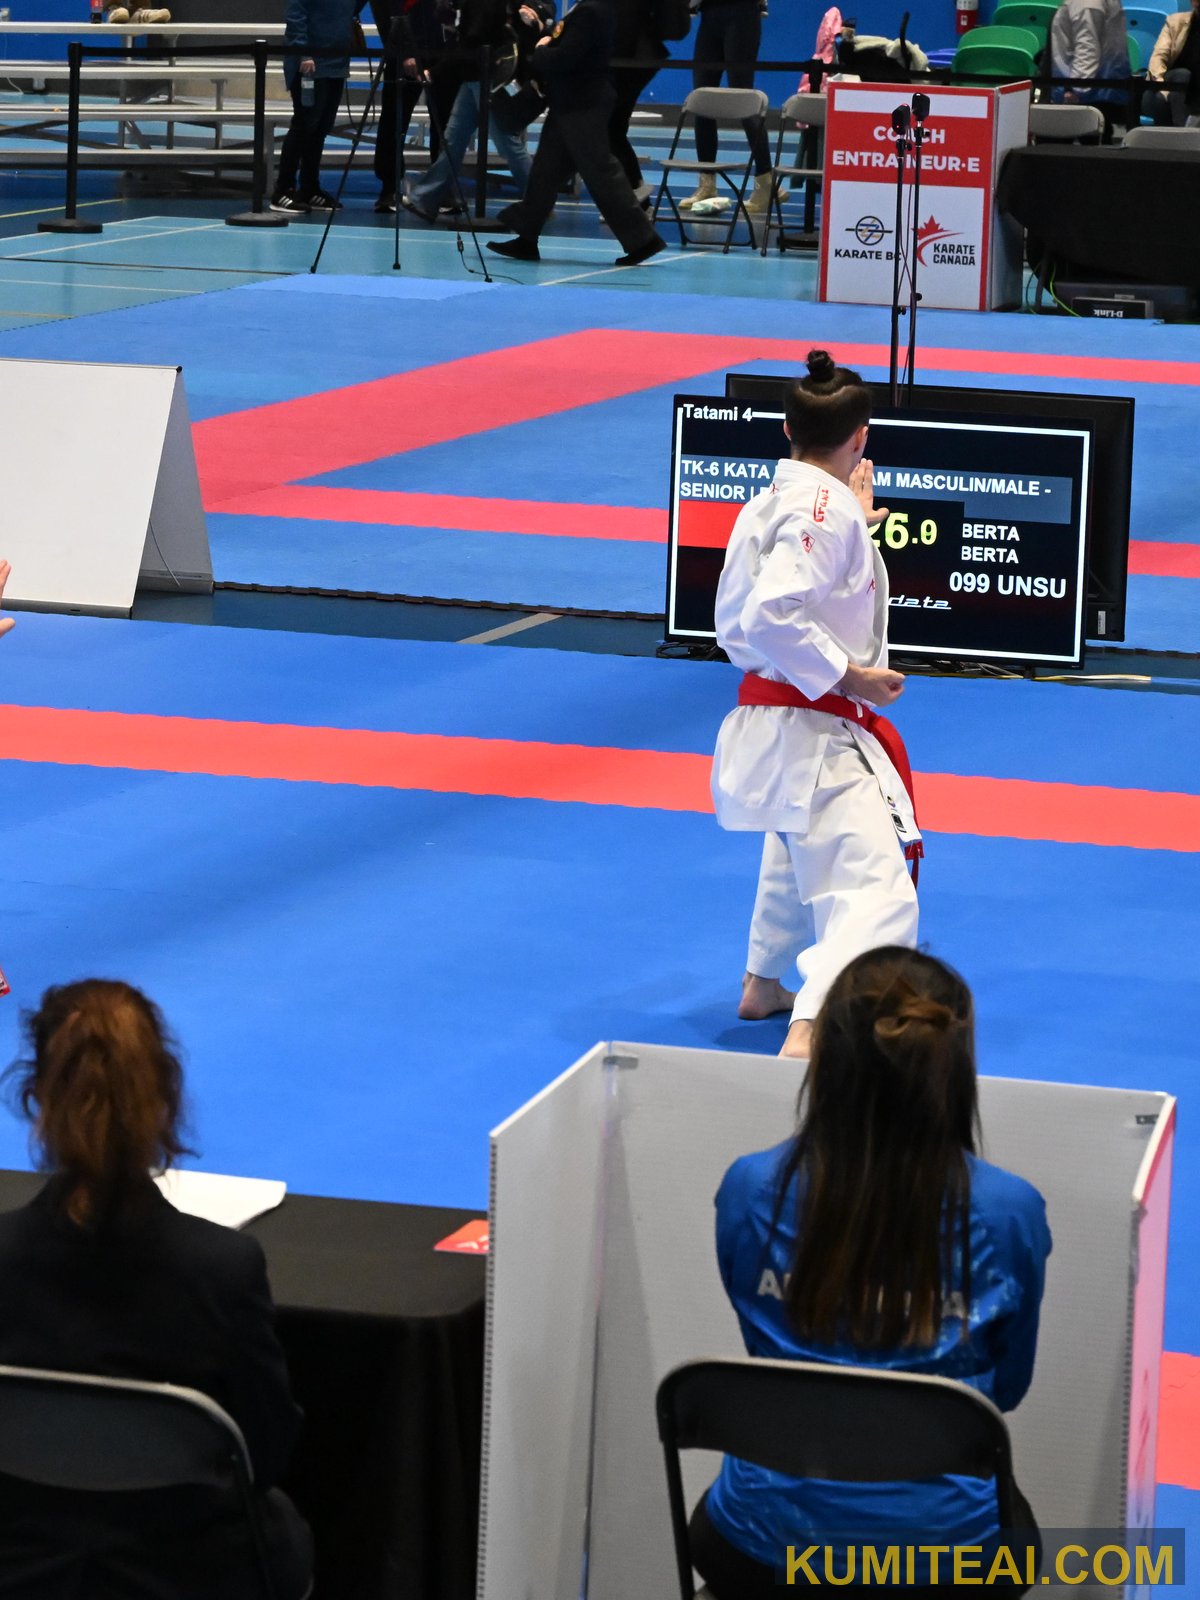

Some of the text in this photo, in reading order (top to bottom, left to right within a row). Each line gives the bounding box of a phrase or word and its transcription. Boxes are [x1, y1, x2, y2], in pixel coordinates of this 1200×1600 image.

[873, 126, 945, 144] COCH
[834, 249, 882, 260] KARATE
[933, 243, 976, 255] KARATE
[933, 254, 976, 266] CANADA
[1093, 309, 1124, 318] D-Link
[683, 403, 753, 422] Tatami 4
[681, 459, 720, 476] TK-6
[724, 462, 771, 479] KATA
[896, 472, 1040, 496] MASCULIN/MALE
[680, 482, 746, 500] SENIOR
[962, 523, 1021, 541] BERTA
[961, 546, 1019, 564] BERTA
[949, 571, 1067, 599] 099 UNSU
